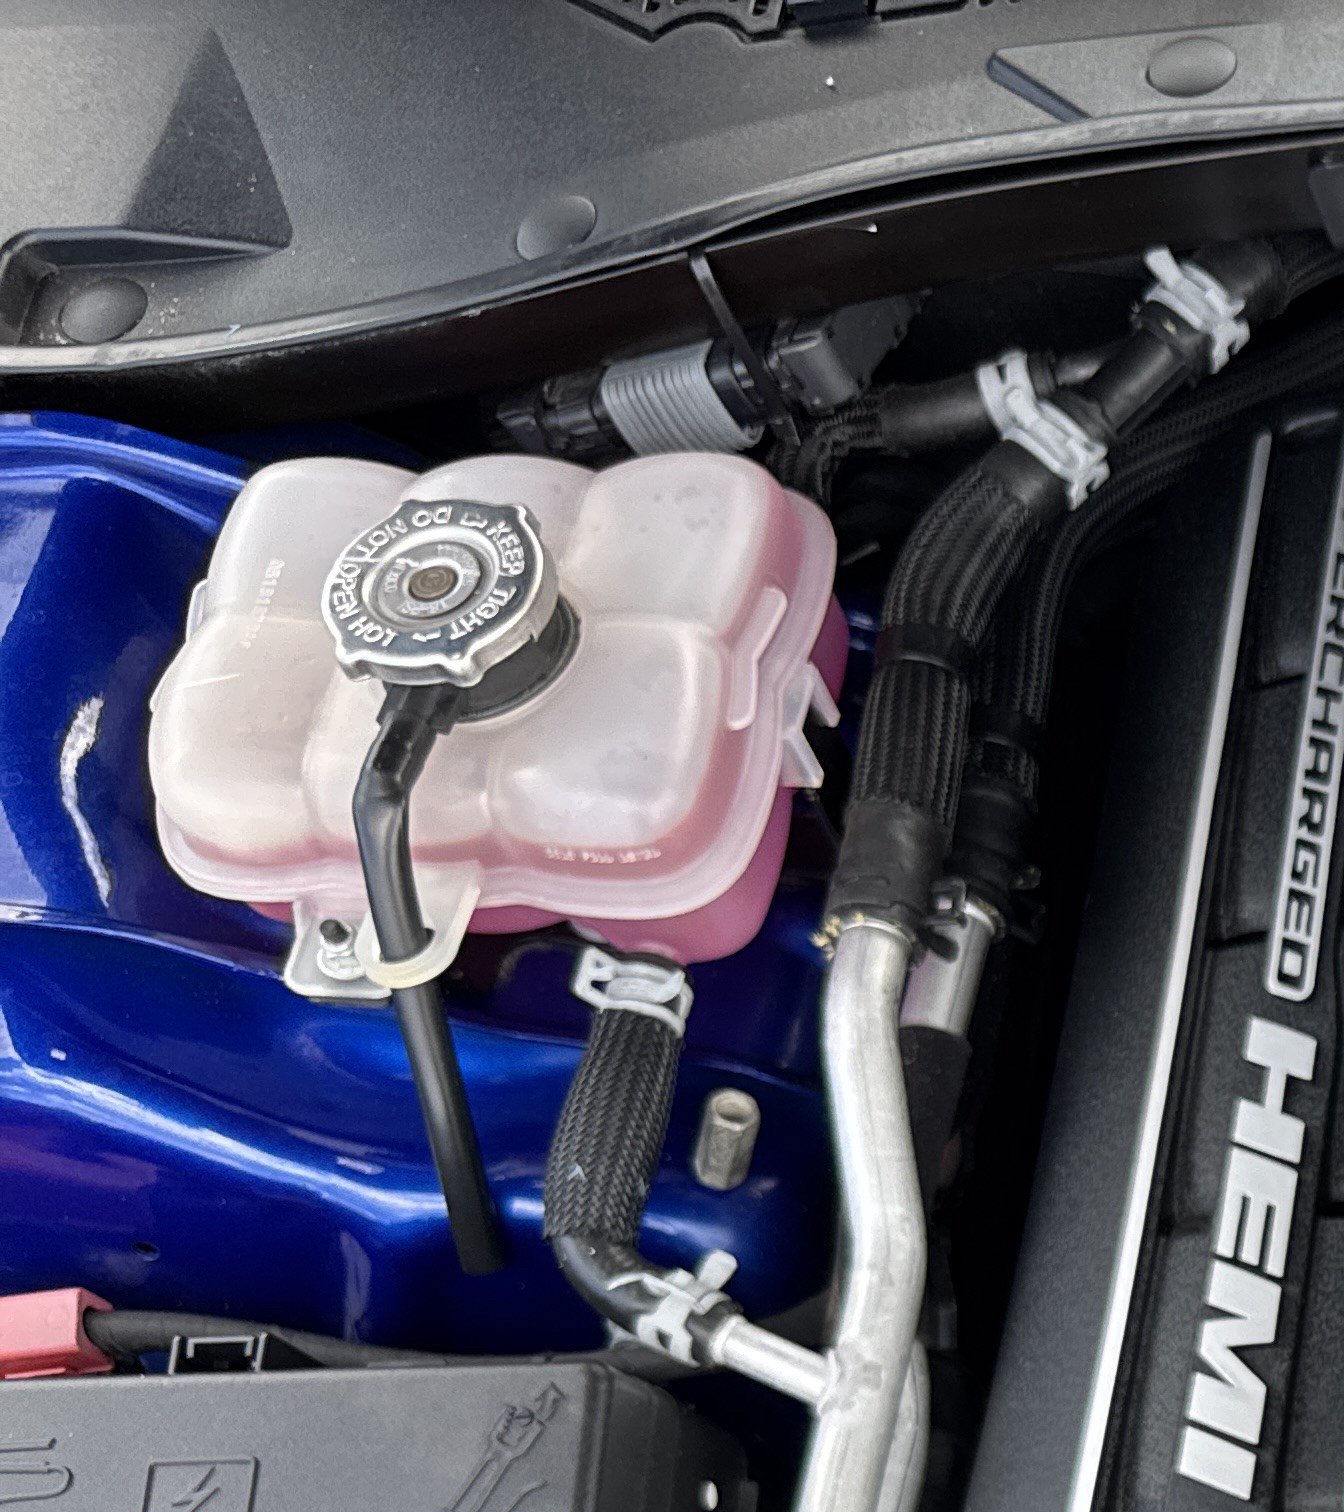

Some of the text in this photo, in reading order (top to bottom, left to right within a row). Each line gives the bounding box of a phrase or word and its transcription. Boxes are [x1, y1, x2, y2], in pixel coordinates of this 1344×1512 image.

[355, 517, 406, 560] NOT
[411, 504, 453, 526] DO
[448, 519, 525, 641] KEEP TIGHT
[1176, 1014, 1318, 1501] HEMI
